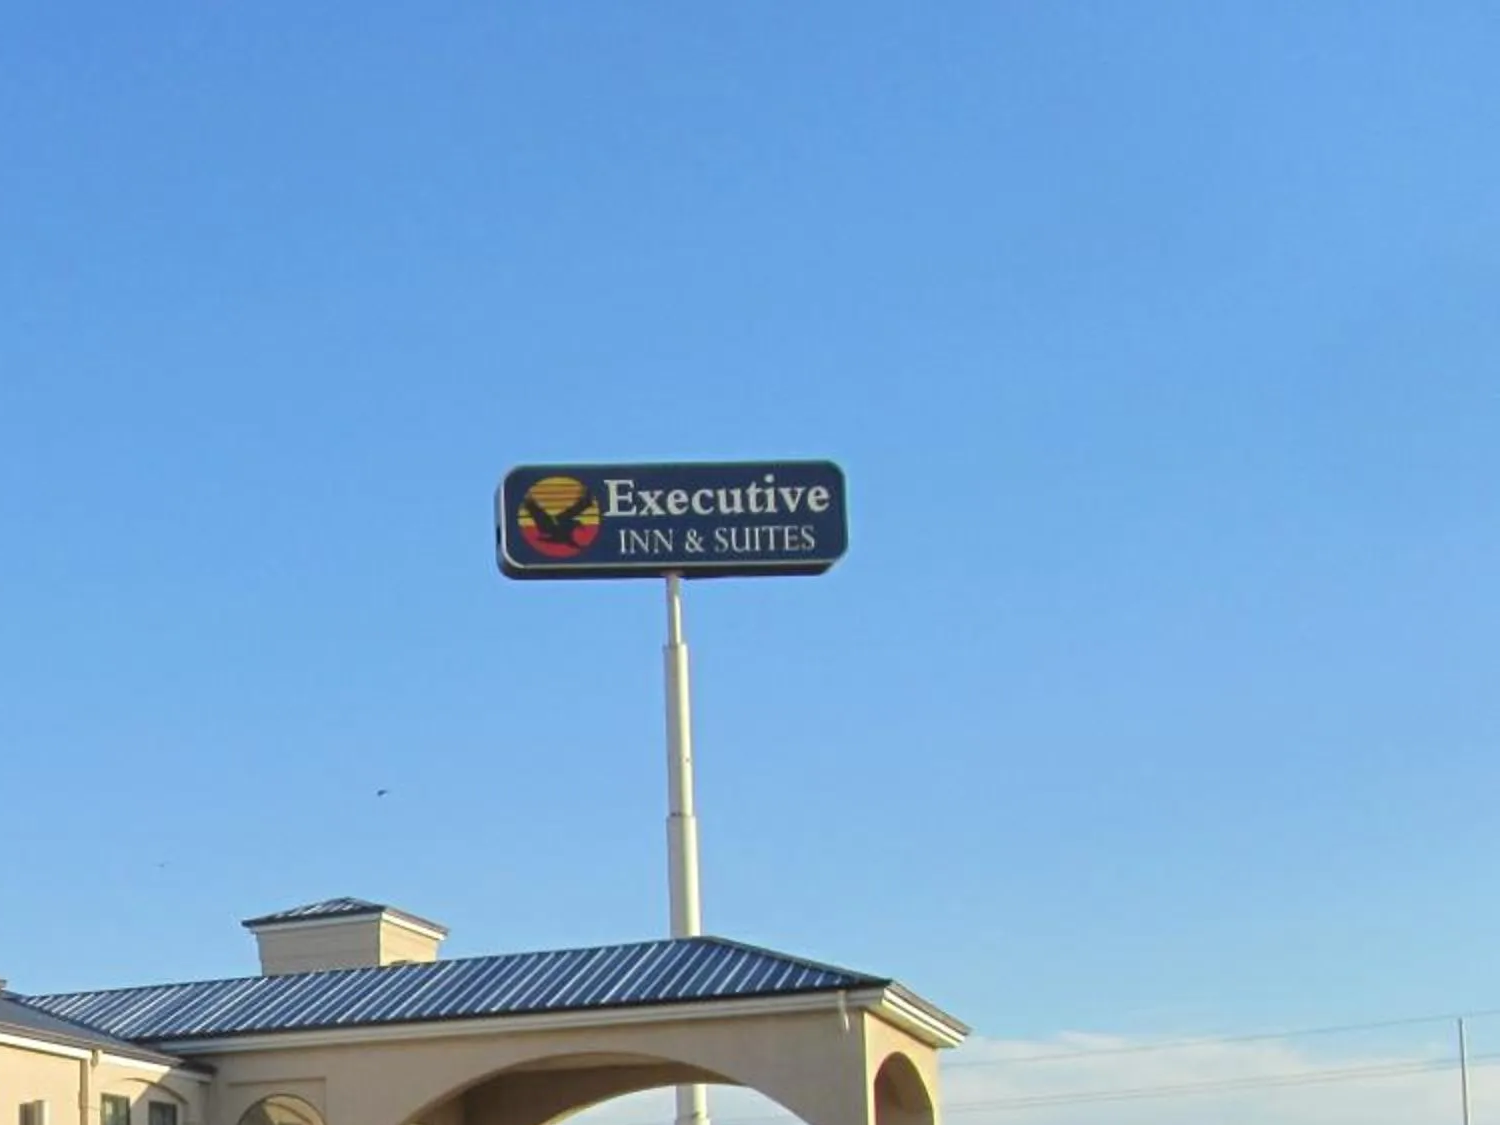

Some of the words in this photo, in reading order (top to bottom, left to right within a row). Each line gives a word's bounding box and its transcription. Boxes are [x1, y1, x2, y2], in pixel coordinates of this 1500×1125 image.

[603, 474, 832, 517] Executive
[619, 529, 674, 554] INN
[685, 528, 705, 553] &
[714, 525, 816, 552] SUITES
